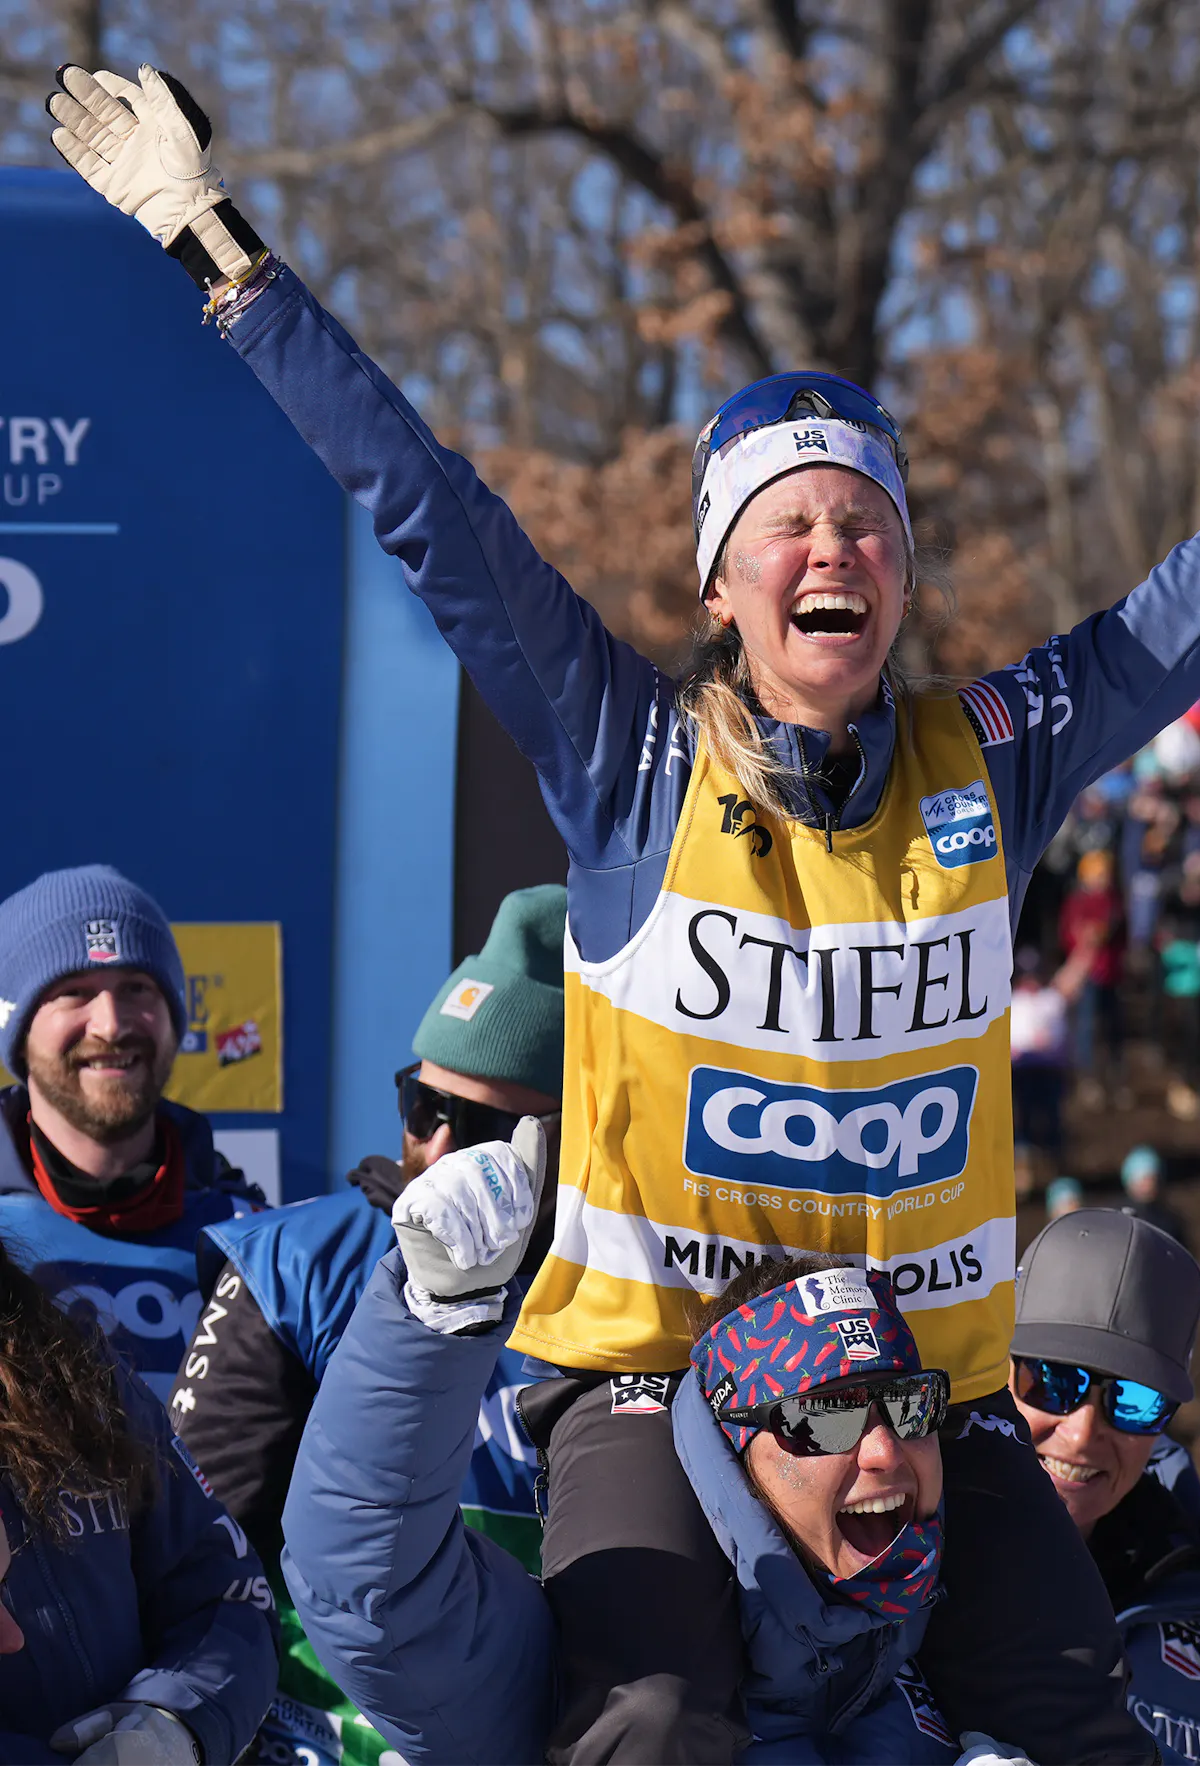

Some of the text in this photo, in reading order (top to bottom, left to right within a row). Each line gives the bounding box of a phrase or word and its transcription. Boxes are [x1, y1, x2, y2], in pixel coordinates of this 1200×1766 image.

[0, 416, 91, 465] RY
[793, 430, 825, 441] US
[944, 791, 976, 805] CROSS
[86, 923, 114, 935] US
[675, 909, 988, 1043] STIFEL
[702, 1085, 960, 1178] coop
[683, 1178, 966, 1221] FIS CROSS COUNTRY WORLD CUP
[825, 1274, 846, 1285] The
[829, 1286, 868, 1298] Memory
[832, 1295, 862, 1305] Clinic
[838, 1320, 870, 1334] US
[612, 1373, 668, 1390] US
